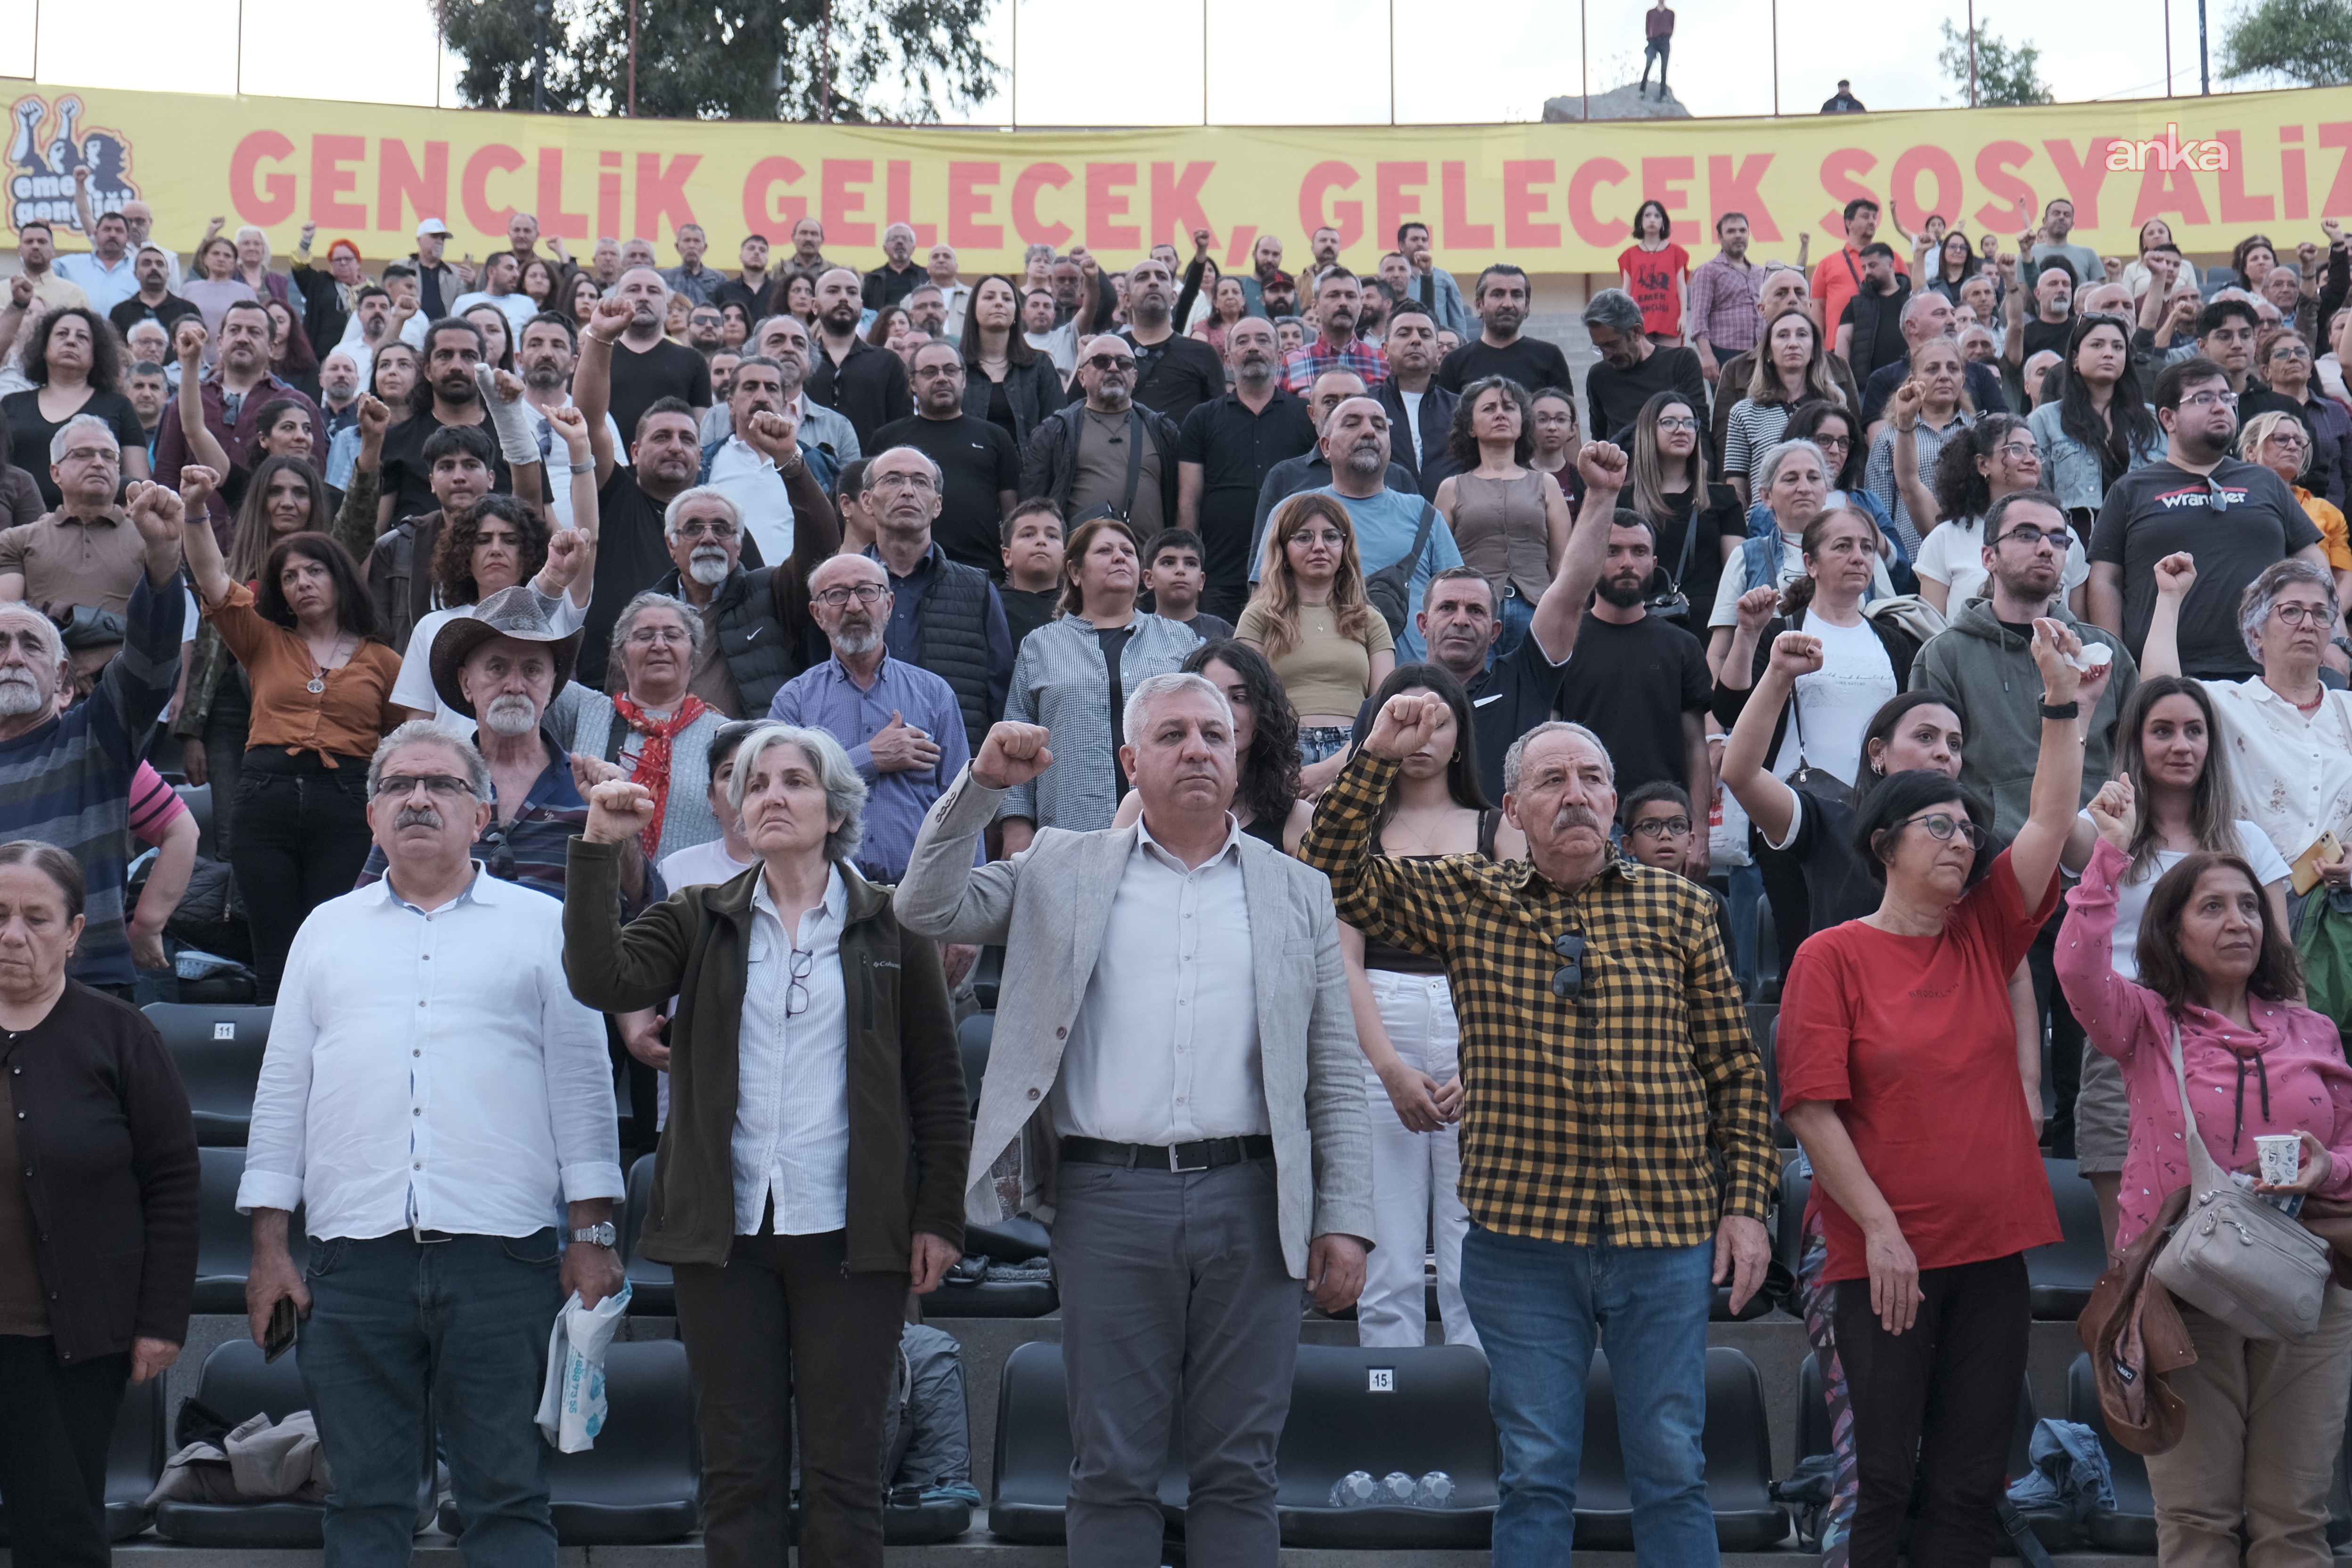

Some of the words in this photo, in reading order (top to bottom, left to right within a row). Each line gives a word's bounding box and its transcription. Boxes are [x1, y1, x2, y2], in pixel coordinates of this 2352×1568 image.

[742, 155, 1258, 267] GELECEK,
[1298, 153, 1784, 250] GELECEK
[1638, 292, 1666, 302] EMEK
[2162, 491, 2246, 509] Wranler
[1908, 982, 1960, 998] BROOKLYN
[219, 1026, 230, 1037] 11
[1374, 1373, 1388, 1387] 15
[570, 1383, 579, 1398] 73
[568, 1400, 577, 1413] 55
